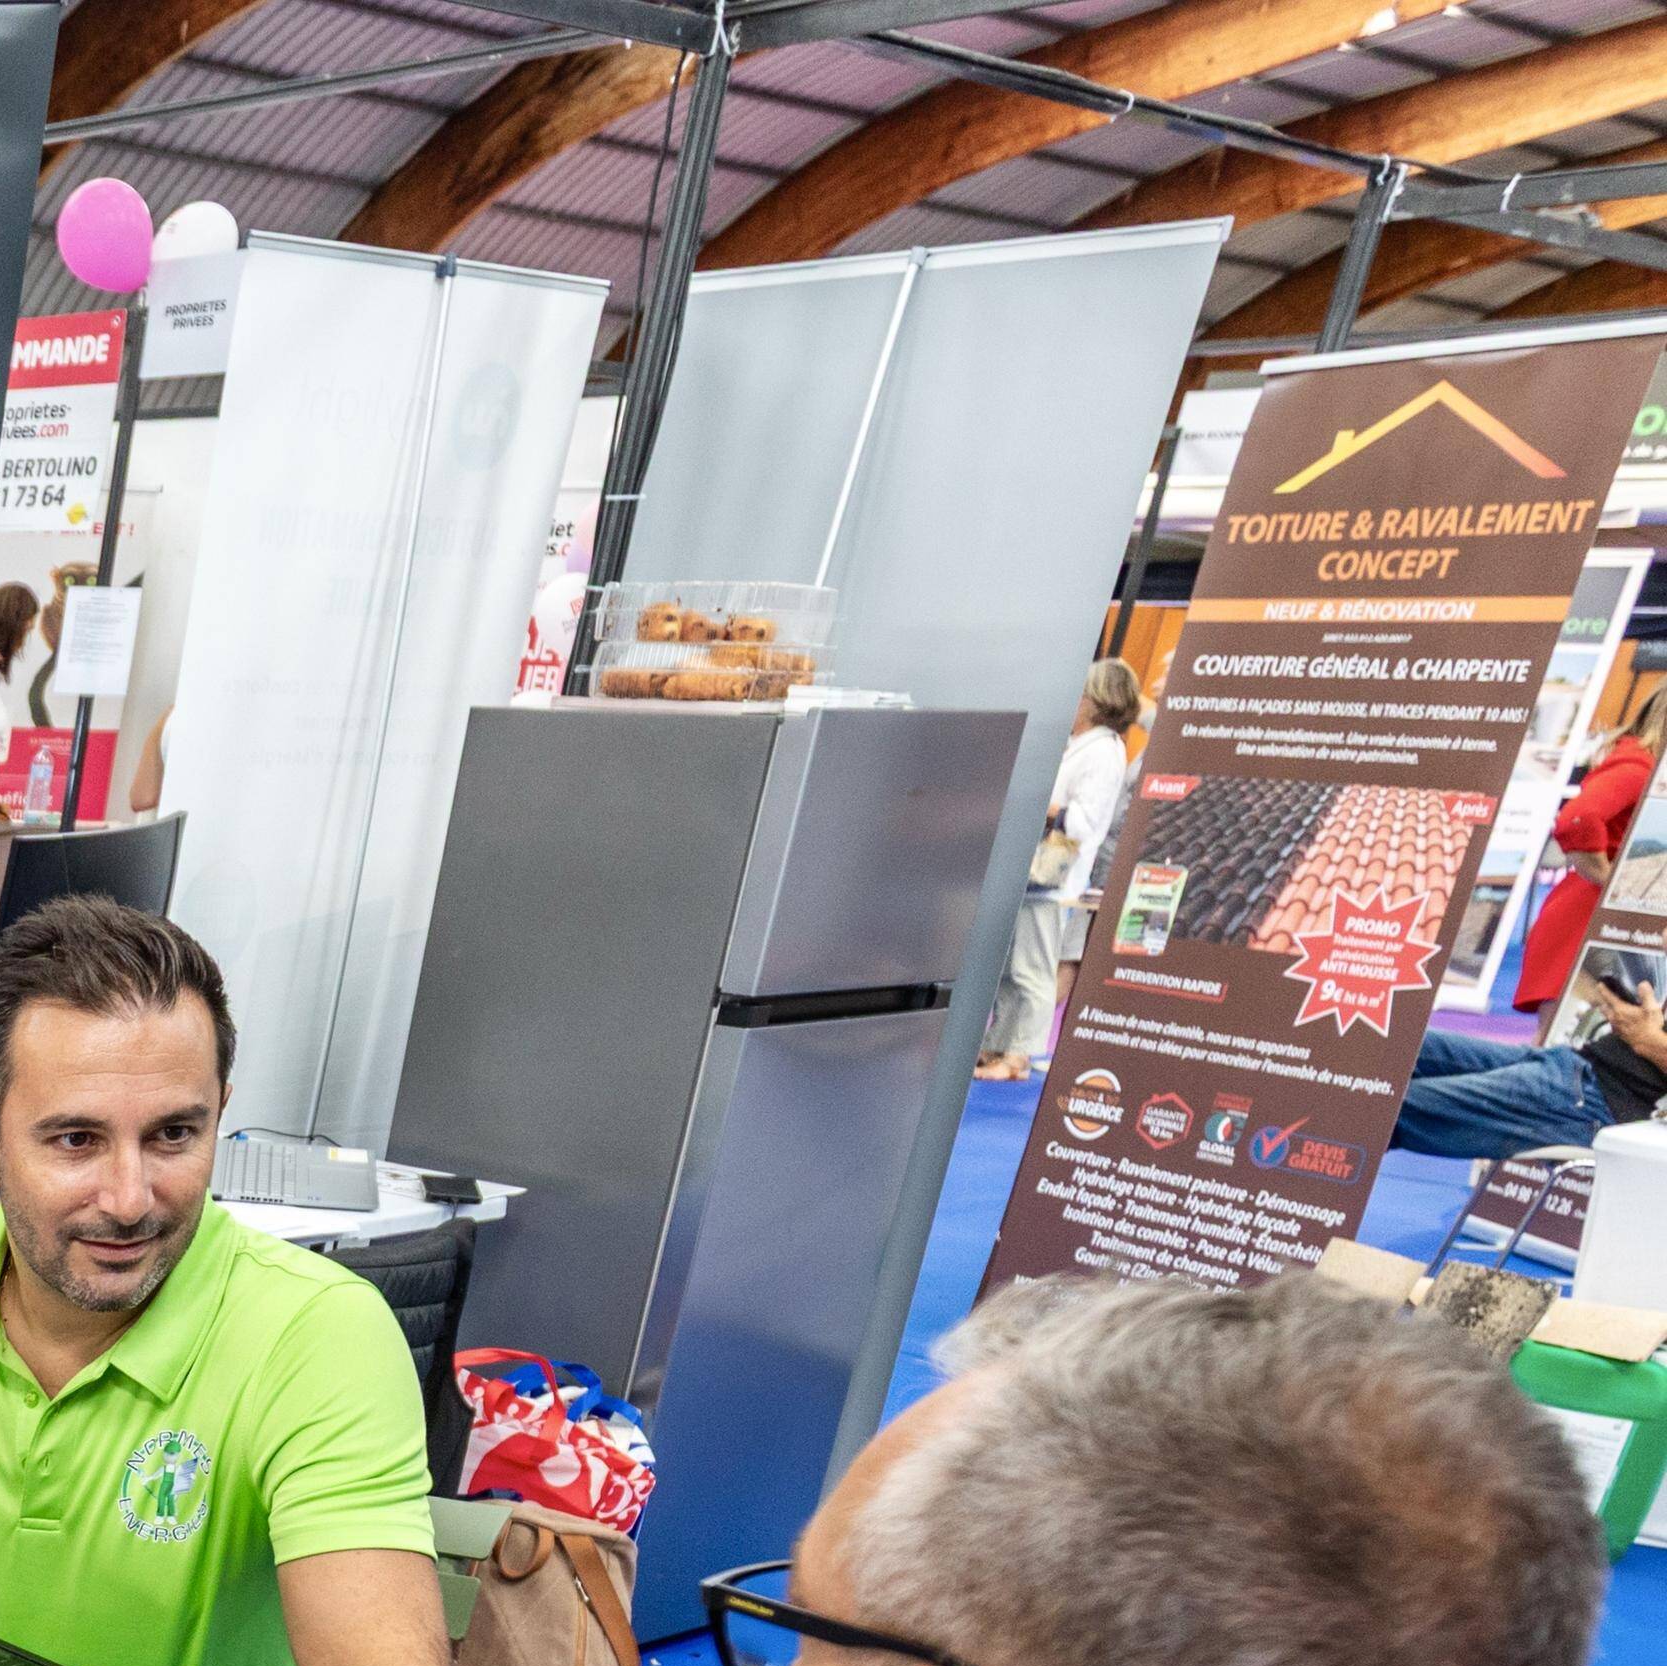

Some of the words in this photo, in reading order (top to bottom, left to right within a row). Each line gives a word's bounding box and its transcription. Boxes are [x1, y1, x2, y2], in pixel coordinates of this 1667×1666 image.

[165, 297, 228, 319] PROPRIETES
[172, 312, 216, 330] PRIVEES
[2, 456, 98, 479] BERTOLINO
[15, 484, 39, 507] 73
[42, 483, 67, 507] 64
[1227, 510, 1347, 544] TOITURE
[1351, 508, 1372, 540] &
[1377, 500, 1596, 539] RAVALEMENT
[1317, 548, 1459, 582] CONCEPT
[1263, 601, 1317, 621] NEUF
[1318, 601, 1337, 621] &
[1337, 599, 1476, 622] RÉNOVATION
[1192, 653, 1308, 679] COUVERTURE
[1307, 653, 1391, 681] GÉNÉRAL
[1393, 657, 1409, 681] &
[1410, 657, 1532, 684] CHARPENTE
[1167, 695, 1192, 712] VOS
[1192, 696, 1238, 713] TOITURES
[1246, 698, 1293, 717] FAÇADES
[1293, 700, 1322, 717] SANS
[1369, 703, 1384, 718] NI
[1384, 703, 1425, 721] TRACES
[1424, 704, 1485, 722] PENDANT
[1485, 707, 1500, 721] 10
[1181, 723, 1198, 738] Un
[1147, 778, 1188, 796] Avant
[1450, 799, 1492, 821] Après
[1345, 916, 1403, 936] PROMO
[1333, 934, 1385, 952] Traitement
[1385, 940, 1405, 955] par
[1114, 967, 1183, 992] INTERVENTION
[1182, 976, 1224, 997] RAPIDE
[1318, 958, 1347, 976] ANTI
[1347, 961, 1401, 982] MOUSSE
[1320, 979, 1344, 1004] 9€
[1124, 1015, 1137, 1030] de
[1137, 1017, 1164, 1036] notre
[1205, 1031, 1232, 1049] nous
[1230, 1035, 1258, 1052] vous
[1256, 1038, 1312, 1062] apportons
[1073, 1027, 1093, 1042] nos
[1093, 1028, 1132, 1048] conseils
[1139, 1037, 1159, 1054] nos
[1180, 1044, 1208, 1064] pour
[1206, 1045, 1263, 1073] concrétiser
[1316, 1069, 1333, 1085] de
[1331, 1072, 1353, 1089] vos
[1067, 1096, 1125, 1124] URGENCE
[1198, 1139, 1237, 1158] GLOBAL
[1302, 1140, 1348, 1164] DEVIS
[1288, 1152, 1354, 1181] GRATUIT
[1045, 1140, 1112, 1170] Couverture
[1116, 1157, 1194, 1190] Ravalement
[1189, 1176, 1249, 1204] peinture
[1255, 1189, 1347, 1228] Démoussage
[1036, 1177, 1078, 1202] Enduit
[1076, 1186, 1117, 1213] façade
[1123, 1199, 1192, 1234] Traitement
[1190, 1215, 1251, 1246] humidité
[1072, 1166, 1135, 1198] Hydrofuge
[1133, 1183, 1178, 1208] toiture
[1183, 1193, 1255, 1228] Hydrofuge
[1253, 1211, 1302, 1239] façade
[1063, 1203, 1114, 1233] Isolation
[1113, 1218, 1137, 1239] des
[1136, 1222, 1189, 1252] combles
[1195, 1239, 1229, 1264] Pose
[1229, 1246, 1247, 1267] de
[1090, 1230, 1158, 1264] Traitement
[1156, 1248, 1173, 1268] de
[1172, 1253, 1240, 1286] charpente
[125, 1430, 213, 1476] NORMES
[118, 1496, 209, 1543] ENERGIES
